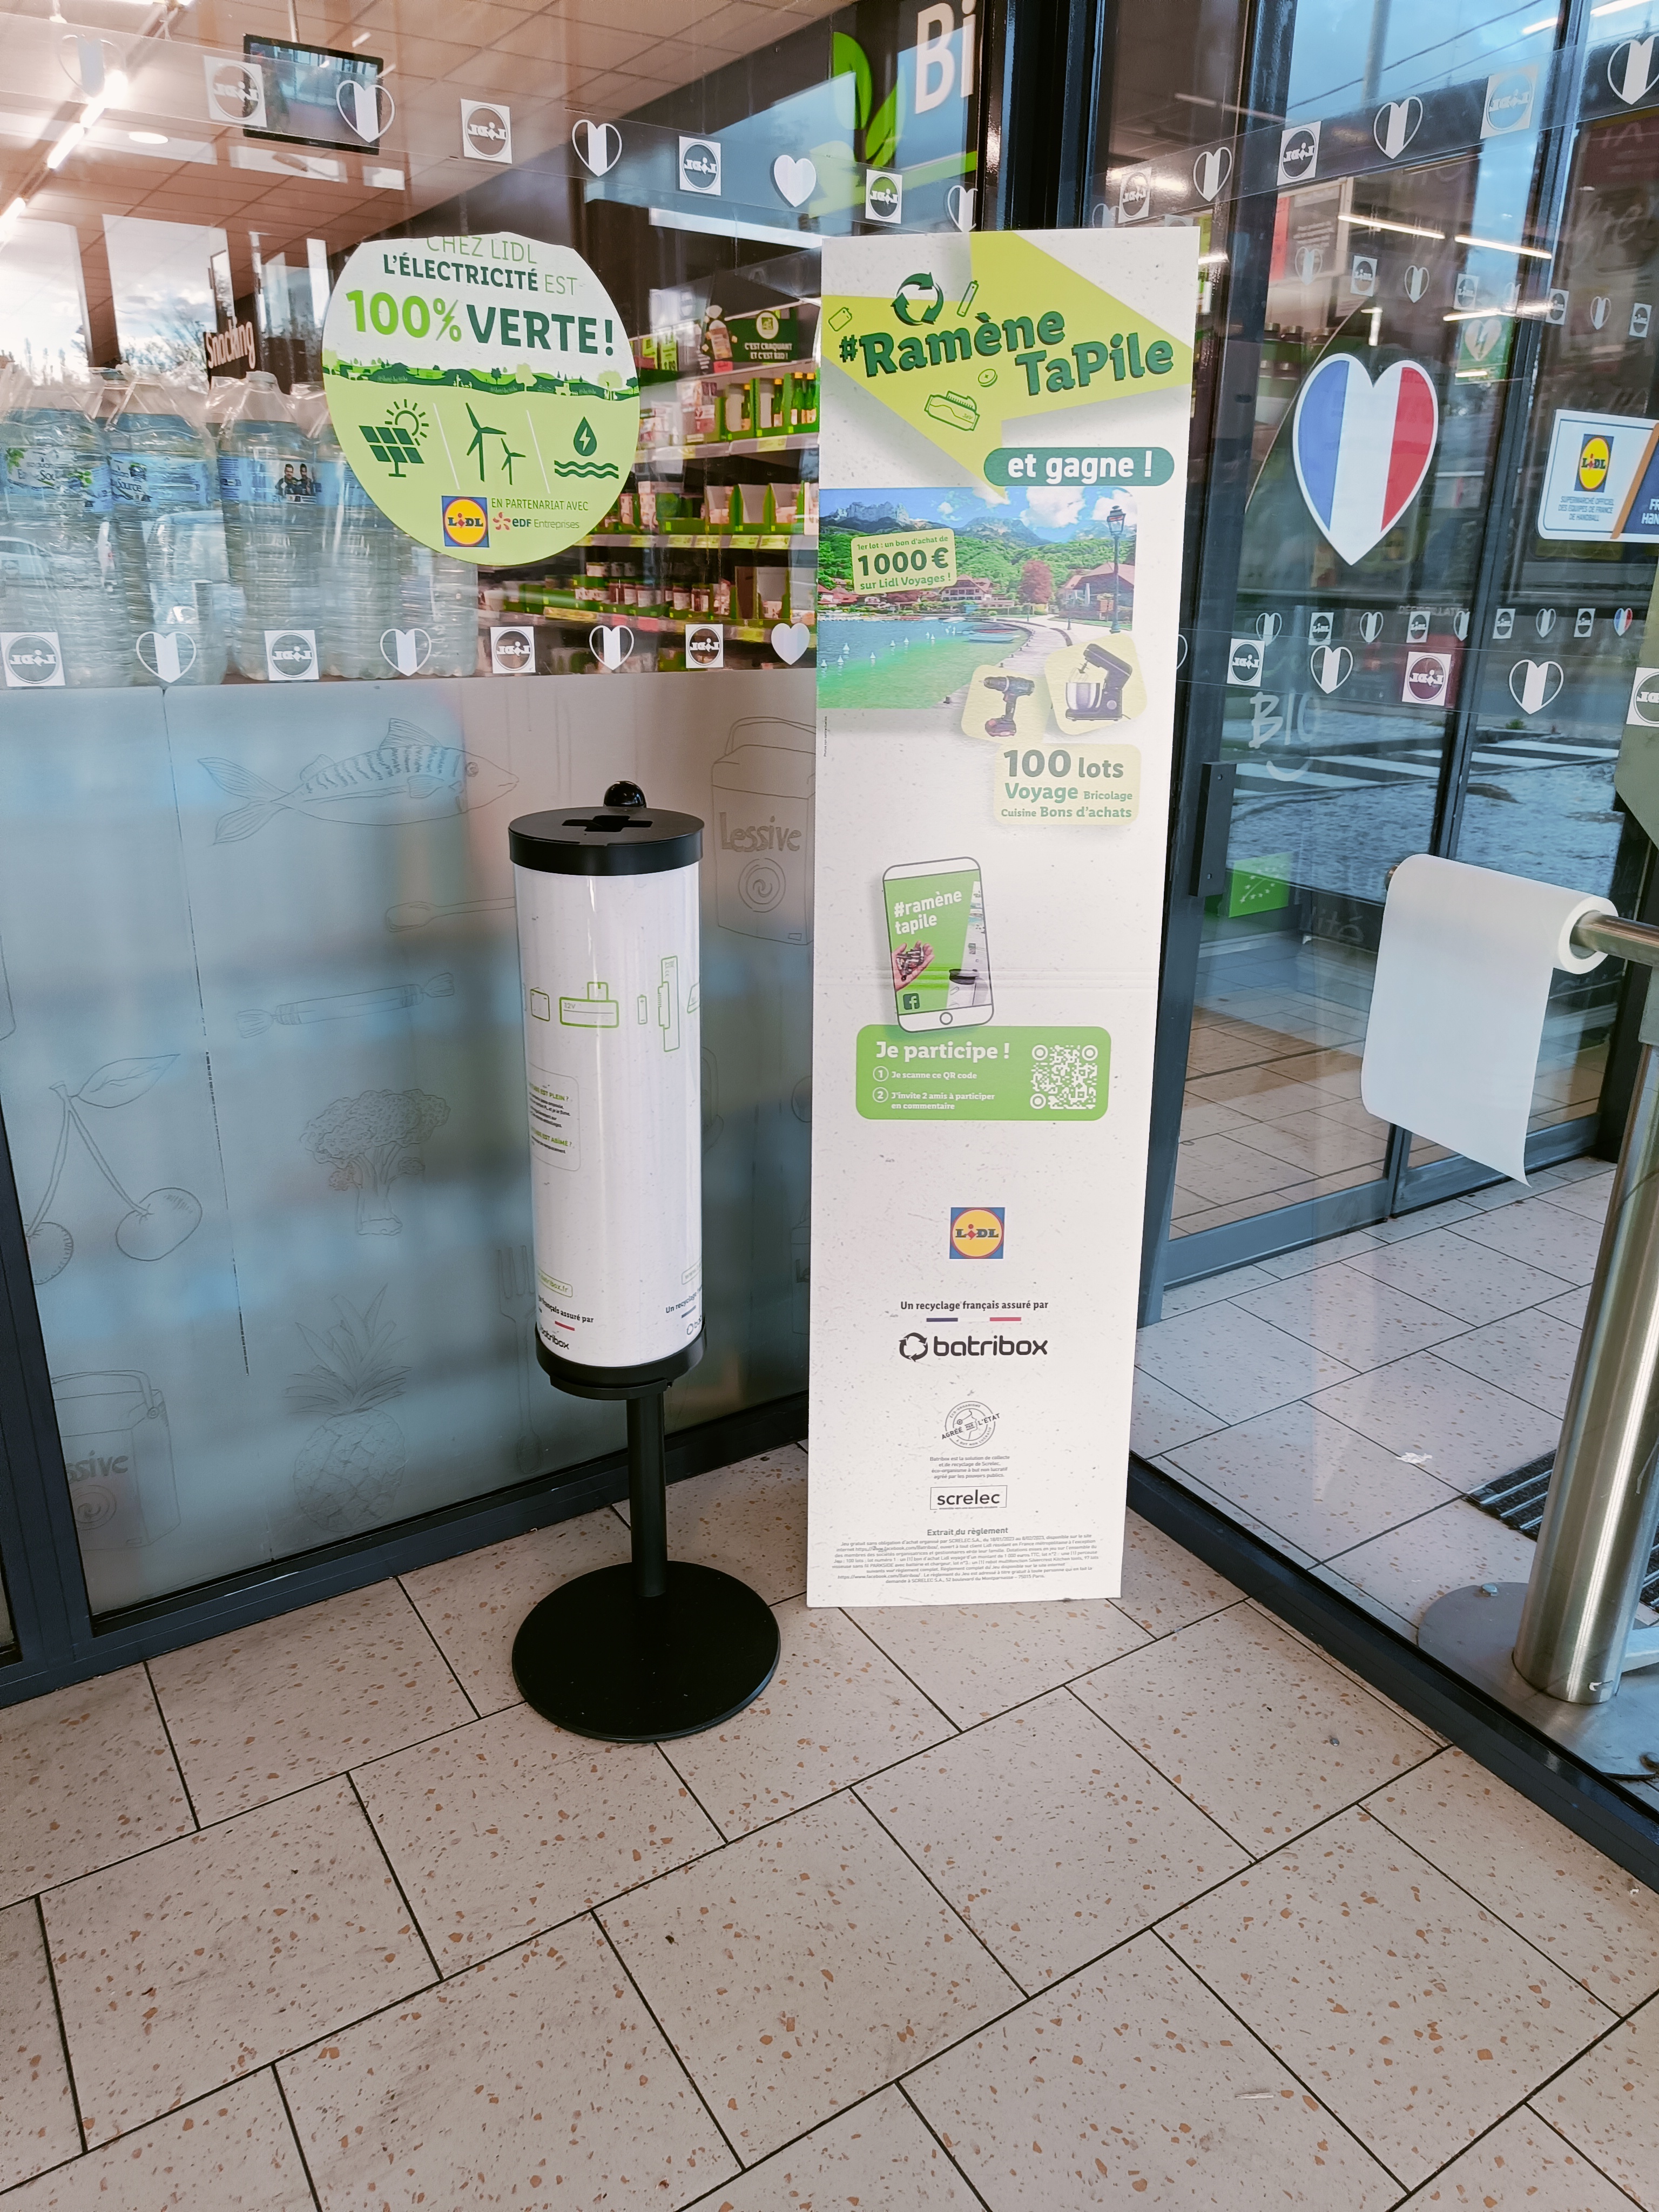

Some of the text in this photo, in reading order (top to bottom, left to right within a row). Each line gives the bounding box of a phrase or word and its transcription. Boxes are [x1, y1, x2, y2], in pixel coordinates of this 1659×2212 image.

[427, 235, 537, 264] CHEZ LIDL
[383, 253, 578, 295] L'ÉLECTRICITÉ EST
[346, 289, 462, 342] 100%
[205, 317, 255, 369] Snacking
[839, 310, 1065, 378] #Ramène
[1015, 332, 1174, 396] TaPile
[1008, 450, 1152, 484] et gagne !
[1582, 453, 1606, 470] LIDL
[491, 498, 588, 511] EN PARTENARIAT AVEC
[448, 513, 483, 528] LIDL
[535, 519, 579, 530] Entreprises
[911, 537, 938, 545] d'achat
[932, 547, 949, 568] €
[860, 572, 951, 590] sur Lidl Voyages !
[1004, 750, 1124, 778] 100 lots
[1004, 783, 1132, 804] Voyage Bricolage
[1001, 806, 1132, 818] Cuisine Bons d'achats
[719, 812, 802, 852] Lessive
[894, 891, 962, 918] #ramène
[894, 914, 937, 935] tapile
[876, 1041, 1010, 1063] Je participe !
[878, 1070, 883, 1078] 1
[943, 1071, 955, 1080] QR
[877, 1091, 884, 1099] 2
[955, 1092, 995, 1101] participer
[955, 1224, 999, 1240] LIDL
[561, 1310, 581, 1320] assuré
[901, 1300, 1049, 1312] Un recyclage français assuré par
[934, 1336, 1048, 1356] batribox
[942, 1427, 962, 1439] AGRÉÉ
[978, 1413, 1000, 1426] L'ÉTAT
[937, 1489, 1000, 1505] screlec
[968, 1527, 1008, 1535] règlement
